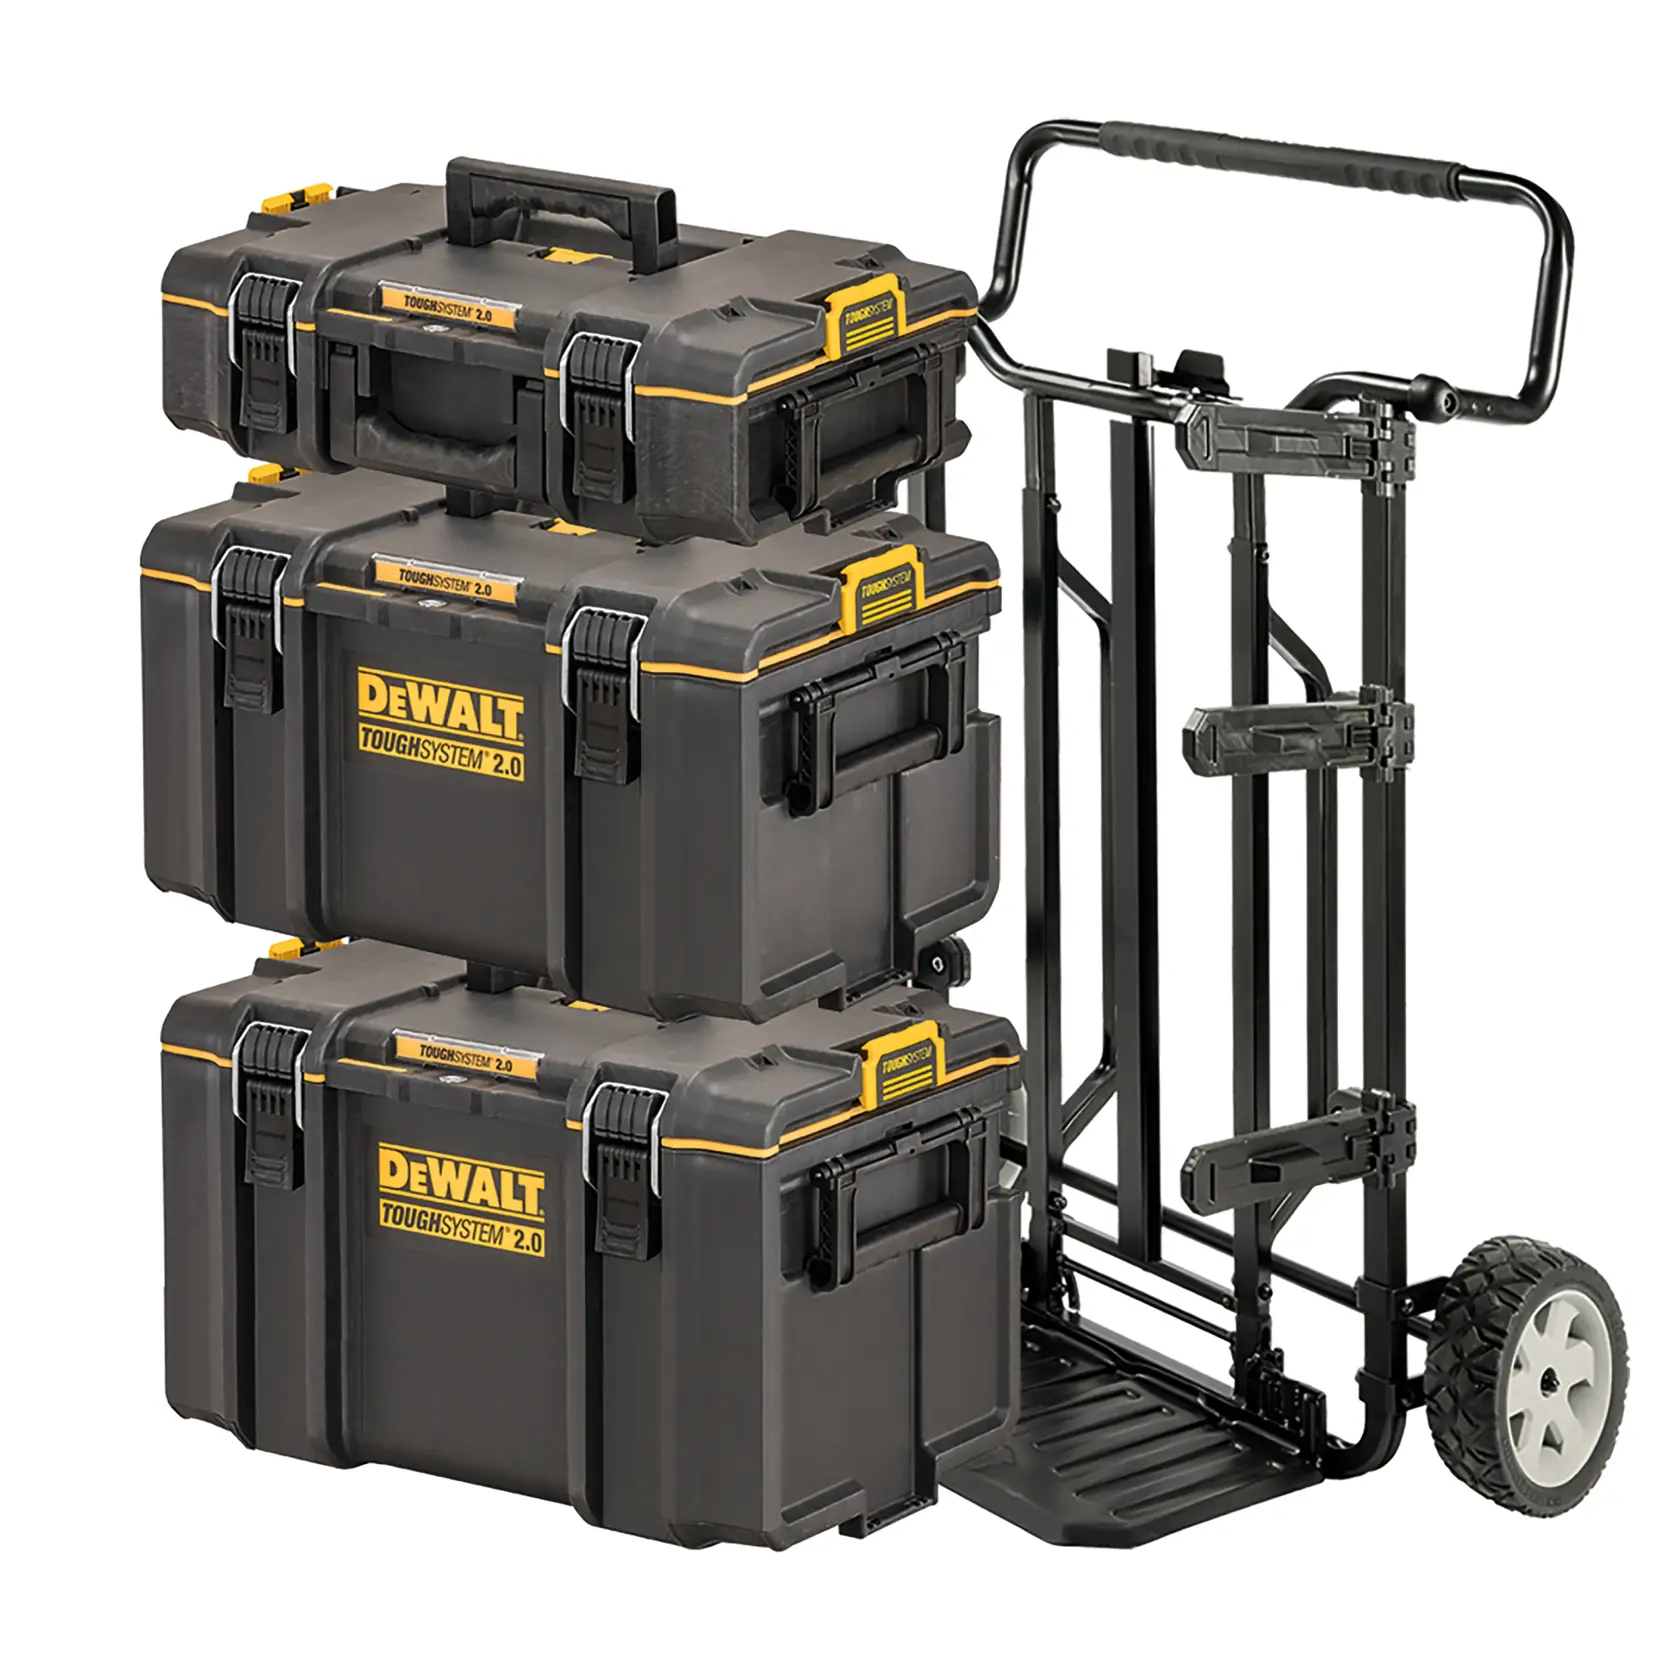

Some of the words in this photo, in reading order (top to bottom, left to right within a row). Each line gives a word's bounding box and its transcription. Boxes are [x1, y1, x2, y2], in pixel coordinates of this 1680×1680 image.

[476, 308, 492, 322] 2.0
[475, 583, 492, 596] 2.0
[493, 753, 522, 777] 2.0
[495, 1058, 513, 1072] 2.0
[514, 1229, 542, 1253] 2.0
